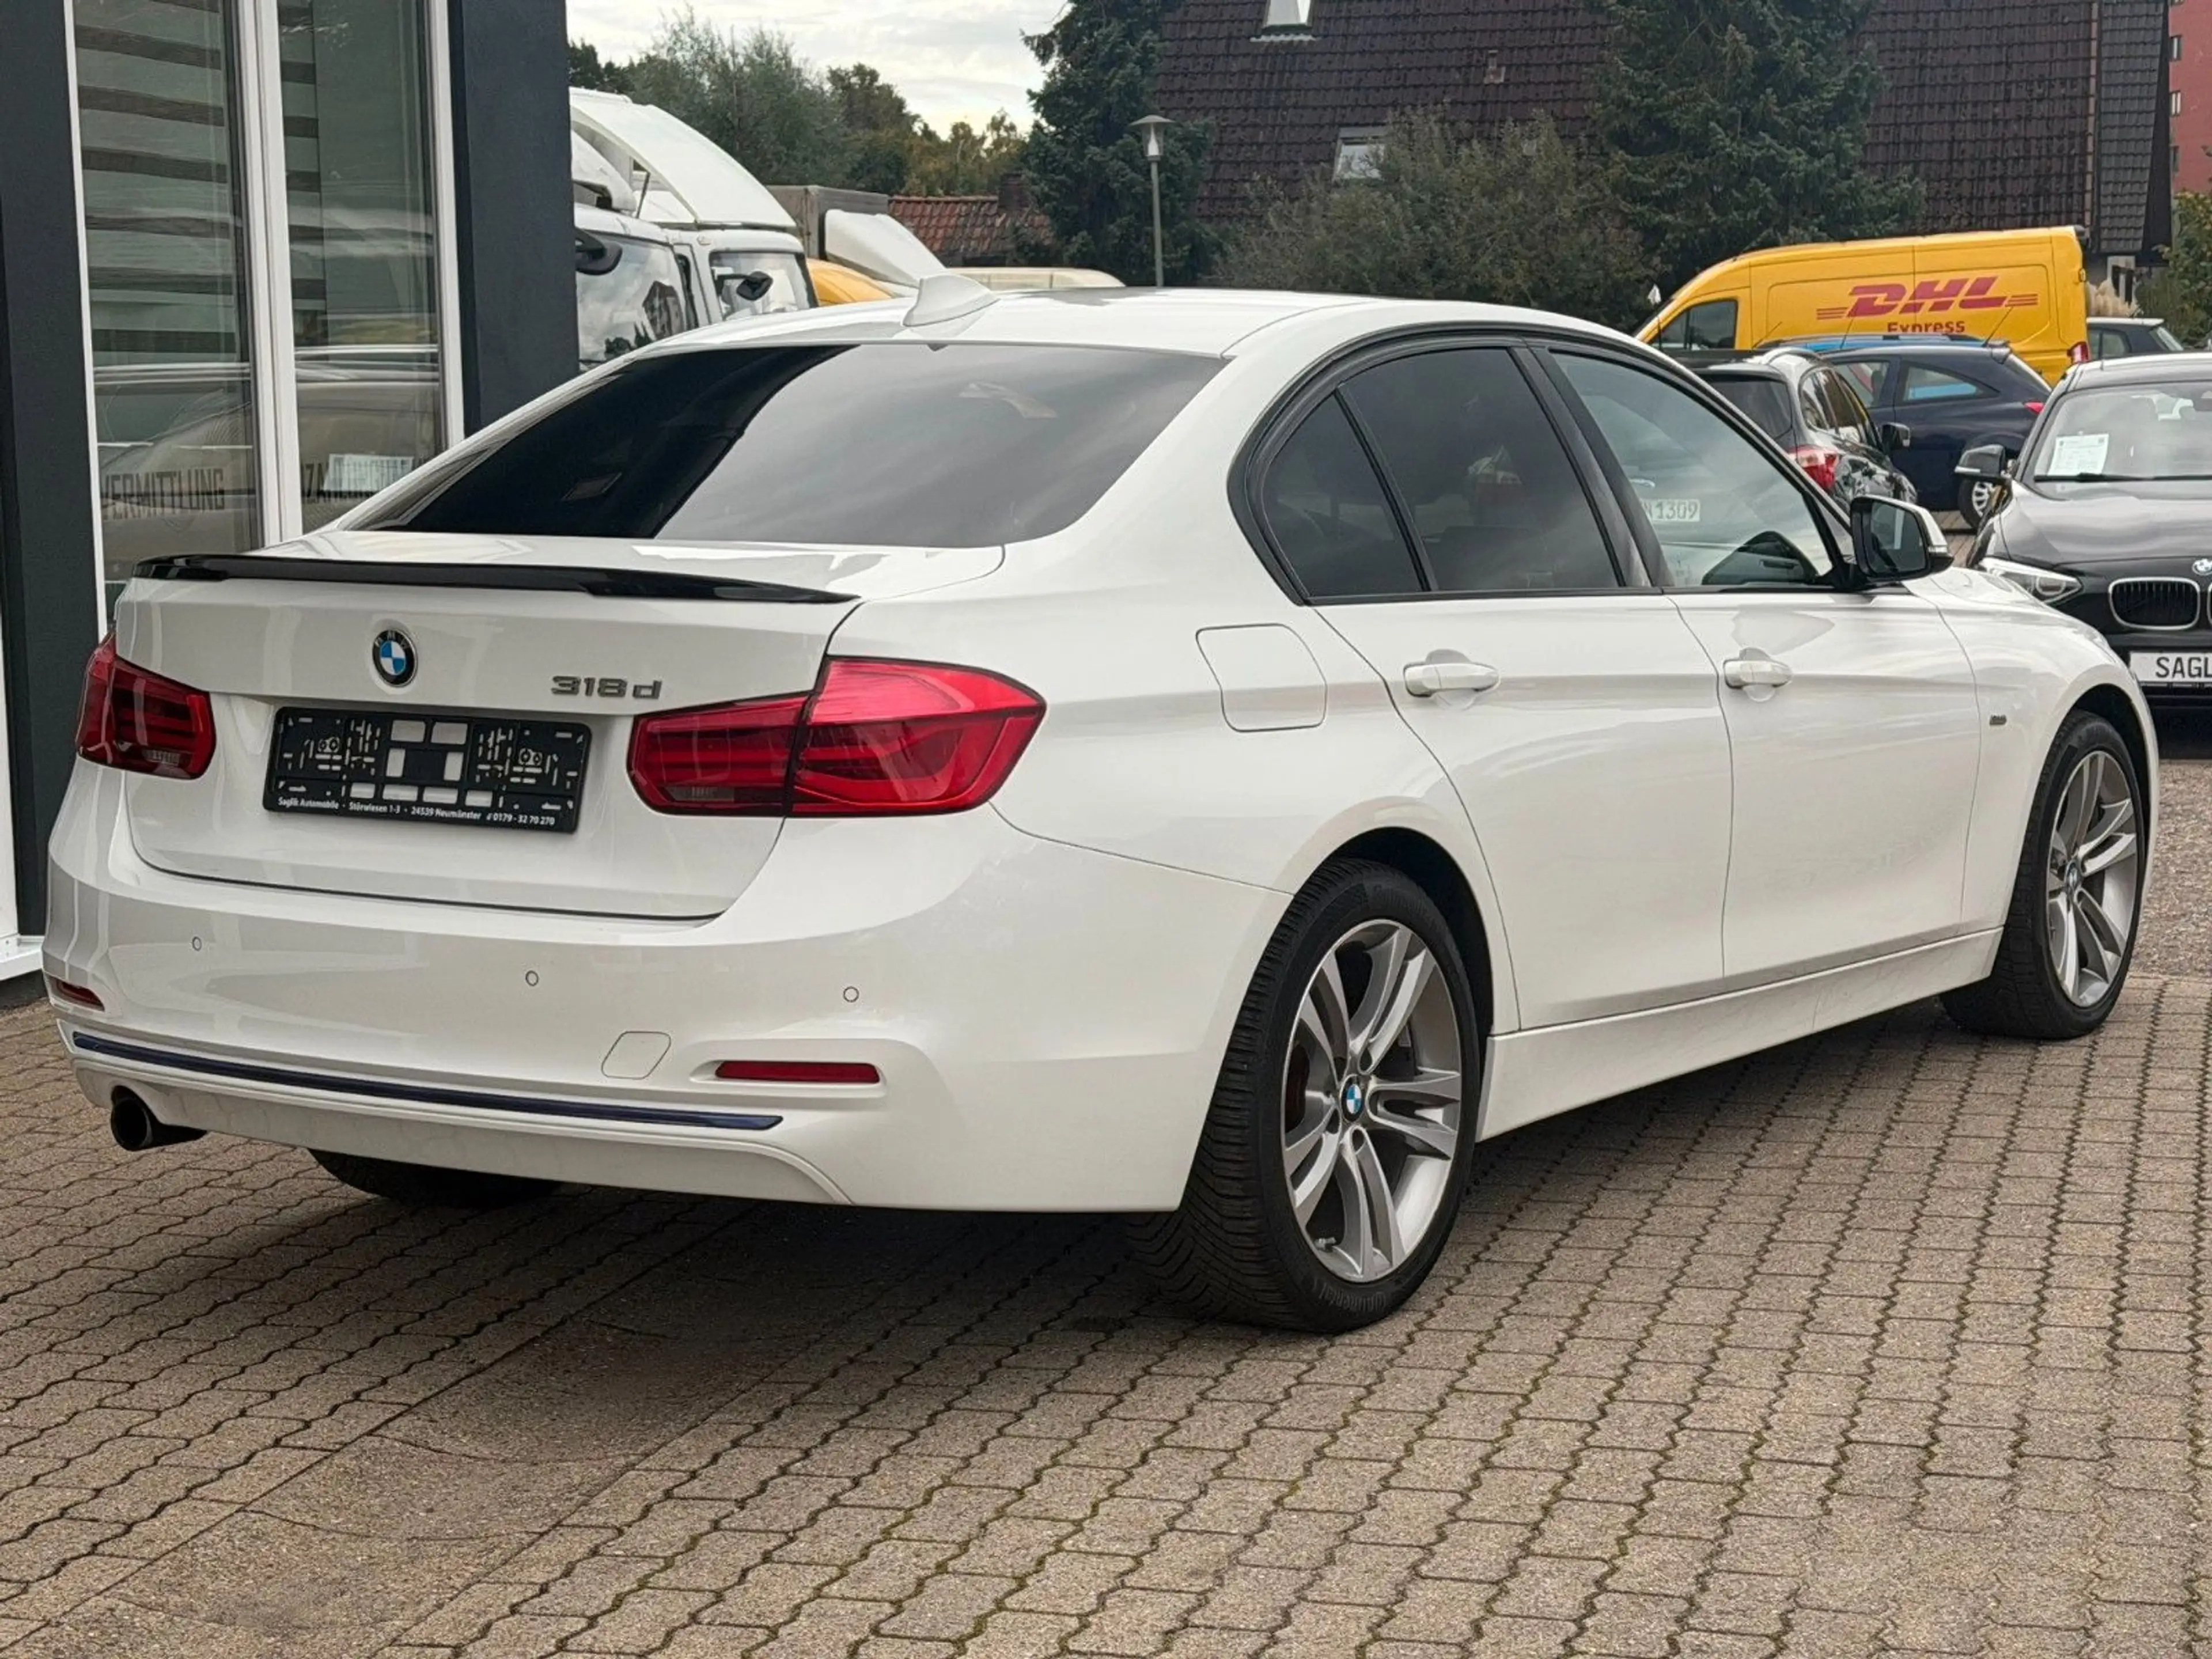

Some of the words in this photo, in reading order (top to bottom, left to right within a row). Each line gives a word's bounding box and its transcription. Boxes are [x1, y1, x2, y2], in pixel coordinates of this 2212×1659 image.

[1847, 276, 2006, 317] DHL
[1655, 501, 1699, 519] 1309
[300, 799, 339, 809] Automobile
[435, 809, 482, 820] Neumünster
[493, 813, 512, 822] 0179
[518, 815, 527, 823] 32
[529, 816, 538, 824] 70
[540, 816, 555, 826] 270
